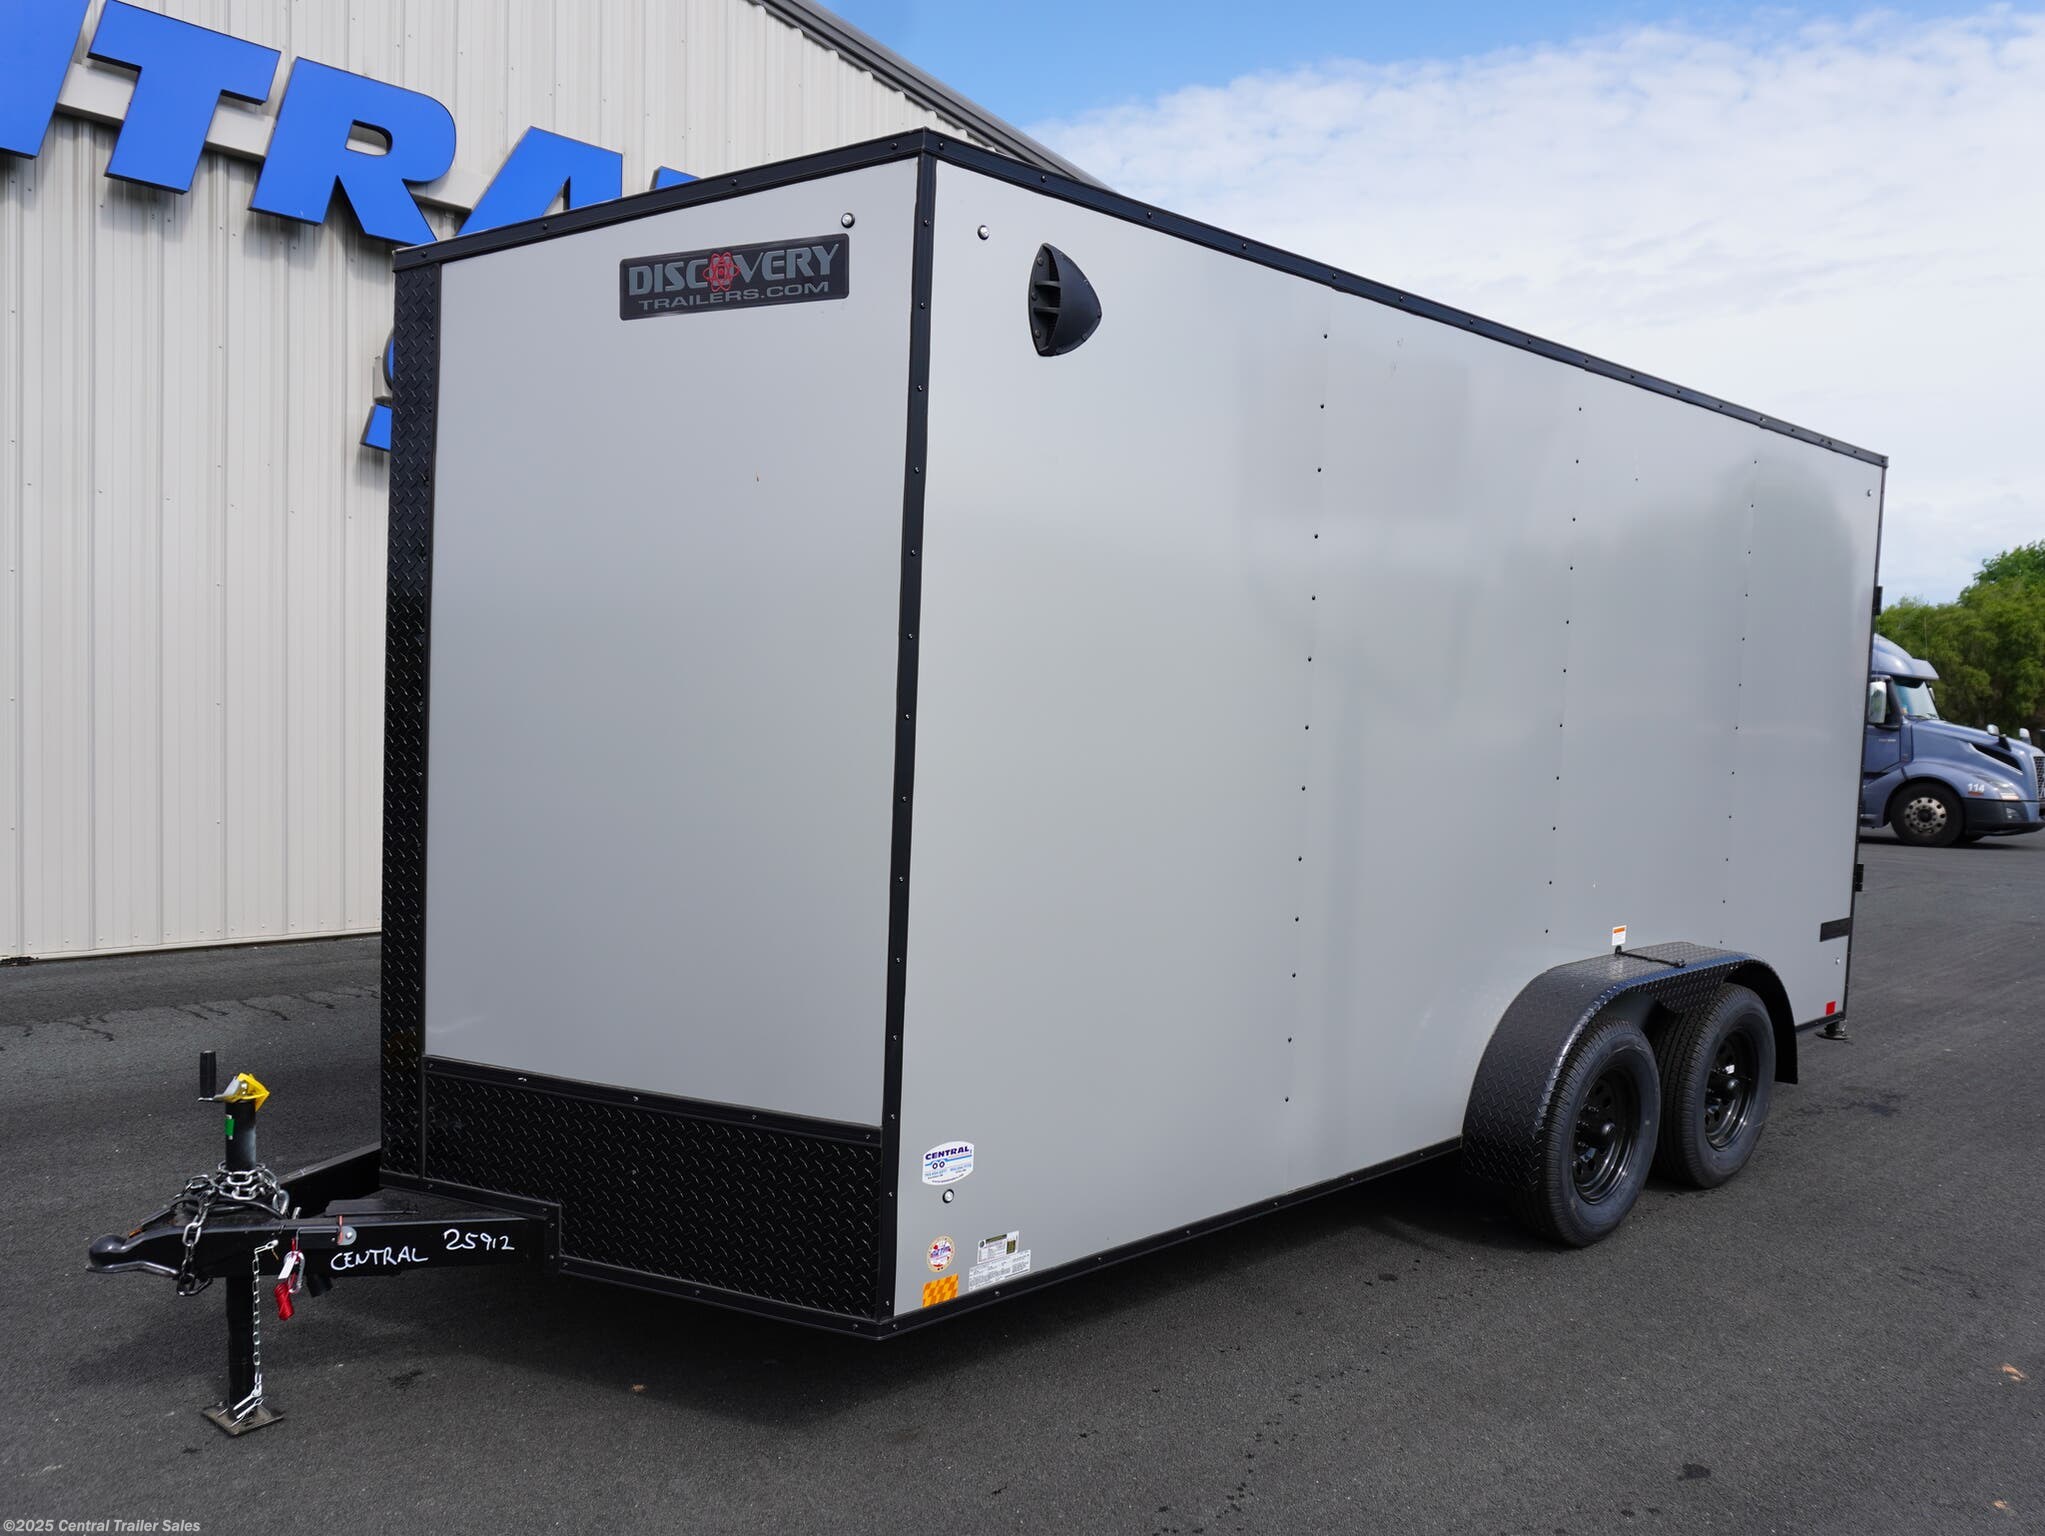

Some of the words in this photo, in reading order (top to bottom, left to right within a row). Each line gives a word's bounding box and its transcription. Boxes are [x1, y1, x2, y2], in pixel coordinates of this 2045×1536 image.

[0, 0, 702, 247] TRA
[628, 243, 839, 297] DISCOVERY
[638, 281, 830, 312] TRAILERS.COM
[925, 1146, 970, 1161] CENTRAL
[330, 1246, 429, 1271] CENTRAL
[443, 1228, 515, 1251] 25912
